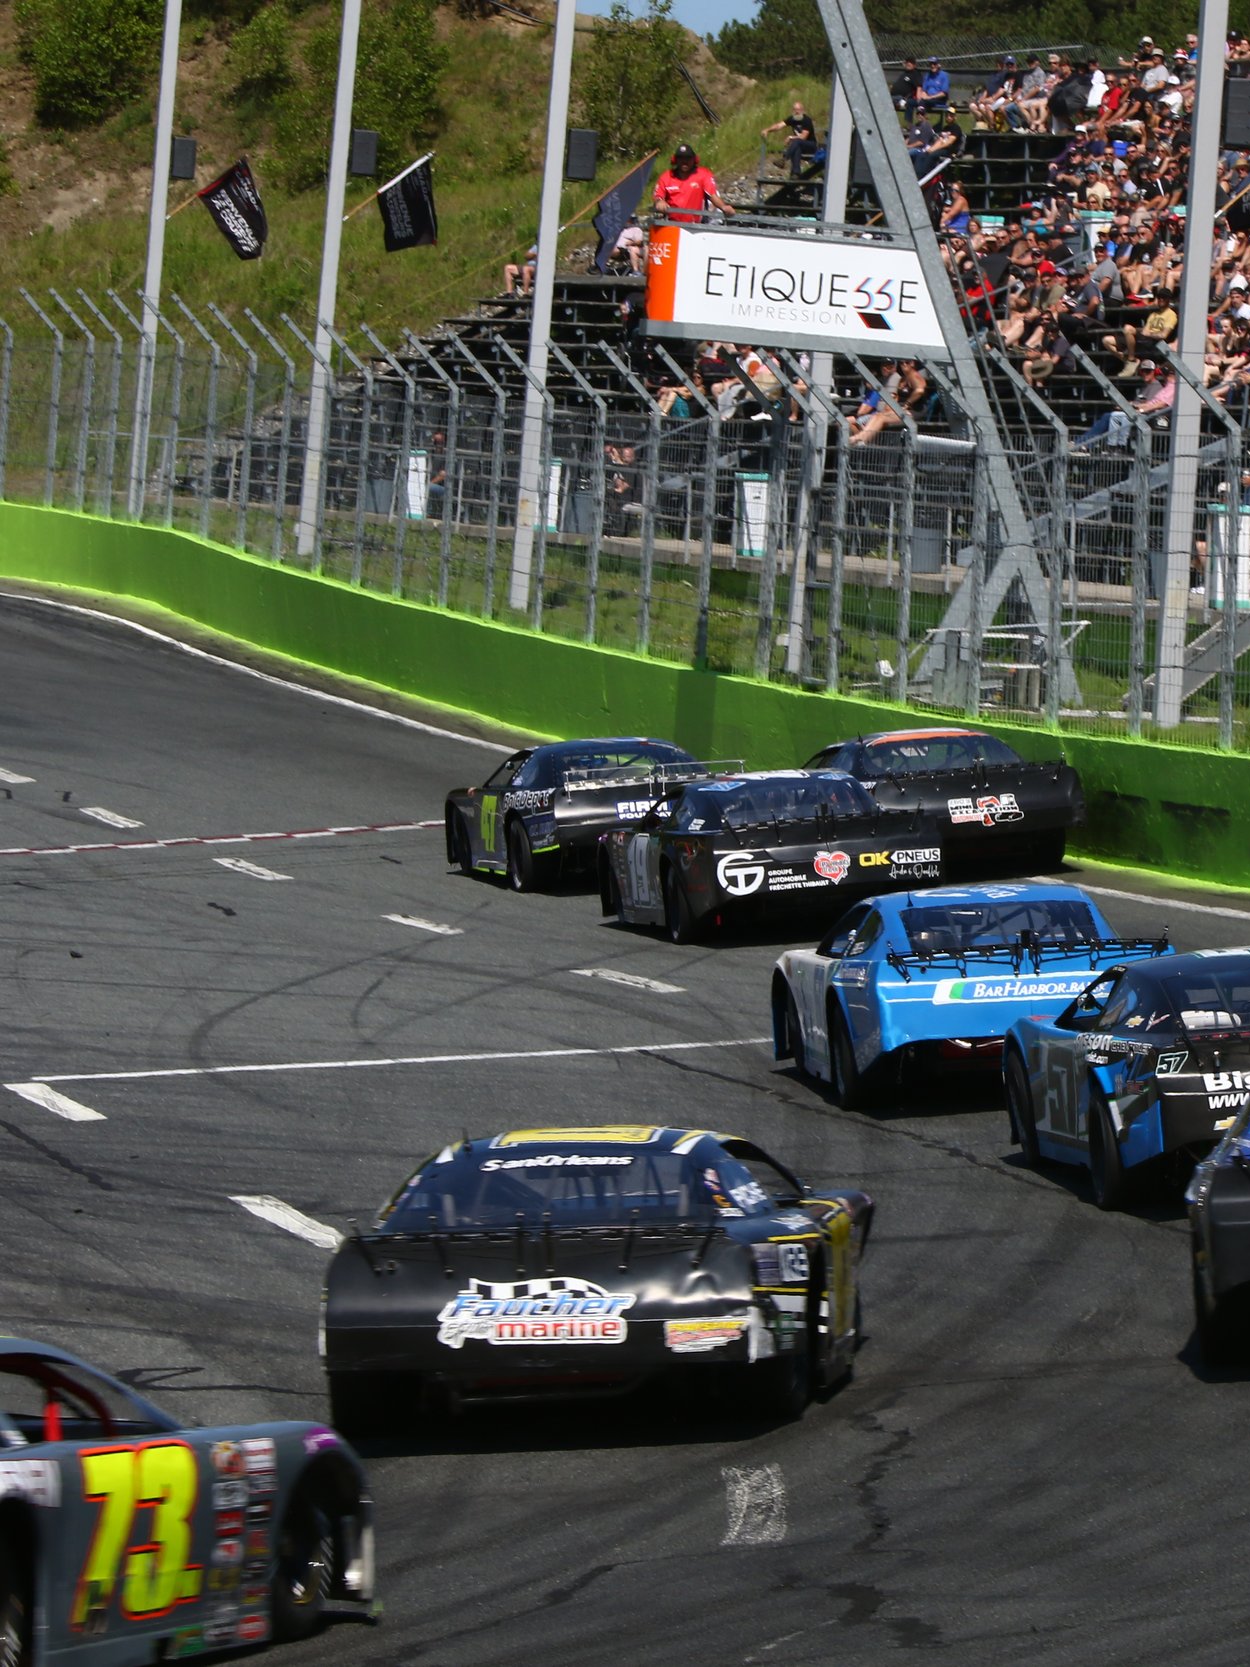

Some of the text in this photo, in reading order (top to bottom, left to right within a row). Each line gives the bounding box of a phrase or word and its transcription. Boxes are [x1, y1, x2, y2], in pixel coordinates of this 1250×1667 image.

[704, 256, 919, 314] ETIQUESSE
[730, 303, 847, 327] IMPRESSION
[616, 800, 668, 813] FIRM
[859, 852, 891, 868] OK
[896, 849, 939, 863] PNEUS
[767, 868, 793, 877] GROUPE
[768, 874, 807, 884] AUTOMOBILE
[802, 879, 829, 889] THIBAULT
[1156, 1051, 1189, 1076] 57
[480, 1153, 635, 1173] SaniOrleans
[450, 1294, 632, 1318] Faucher
[496, 1318, 621, 1338] marine
[70, 1438, 203, 1632] 73
